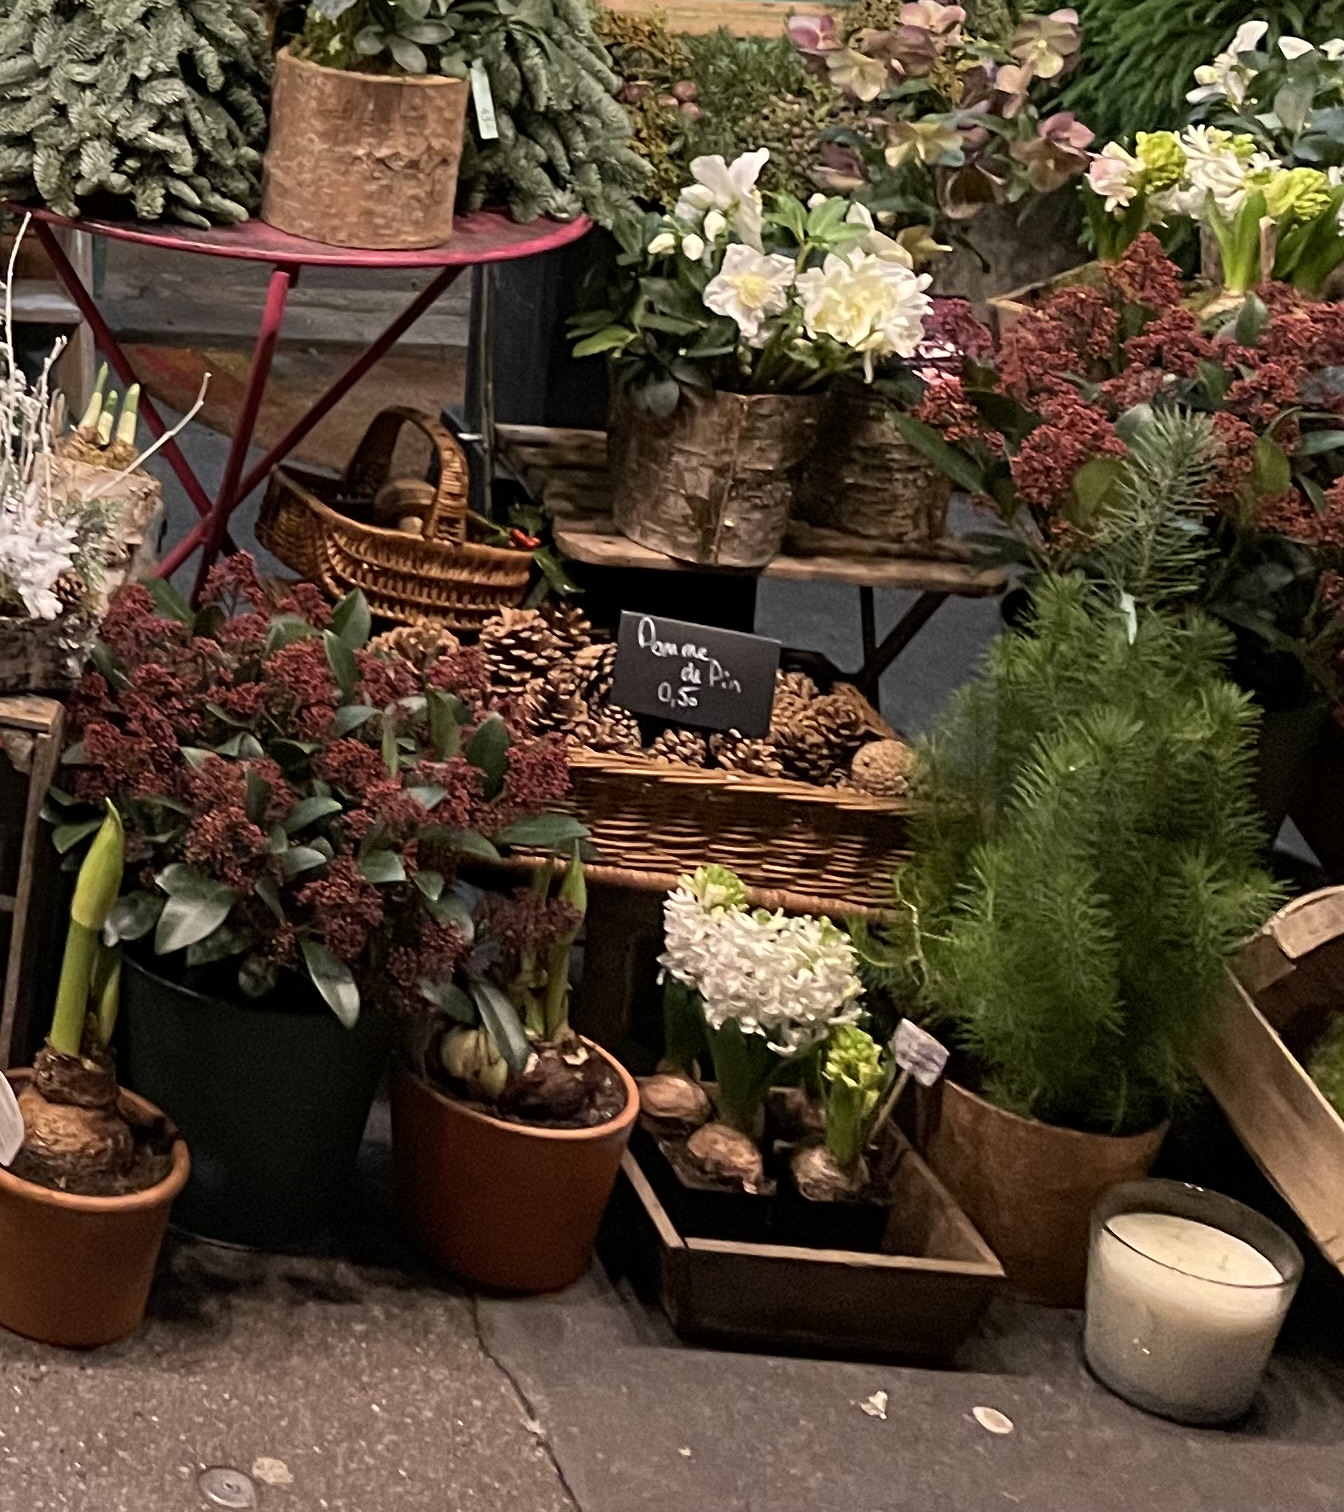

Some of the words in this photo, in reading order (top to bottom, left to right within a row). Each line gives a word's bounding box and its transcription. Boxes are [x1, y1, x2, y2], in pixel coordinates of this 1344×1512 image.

[637, 616, 711, 662] Pomme
[709, 659, 742, 694] Pin
[657, 681, 700, 708] 0,50
